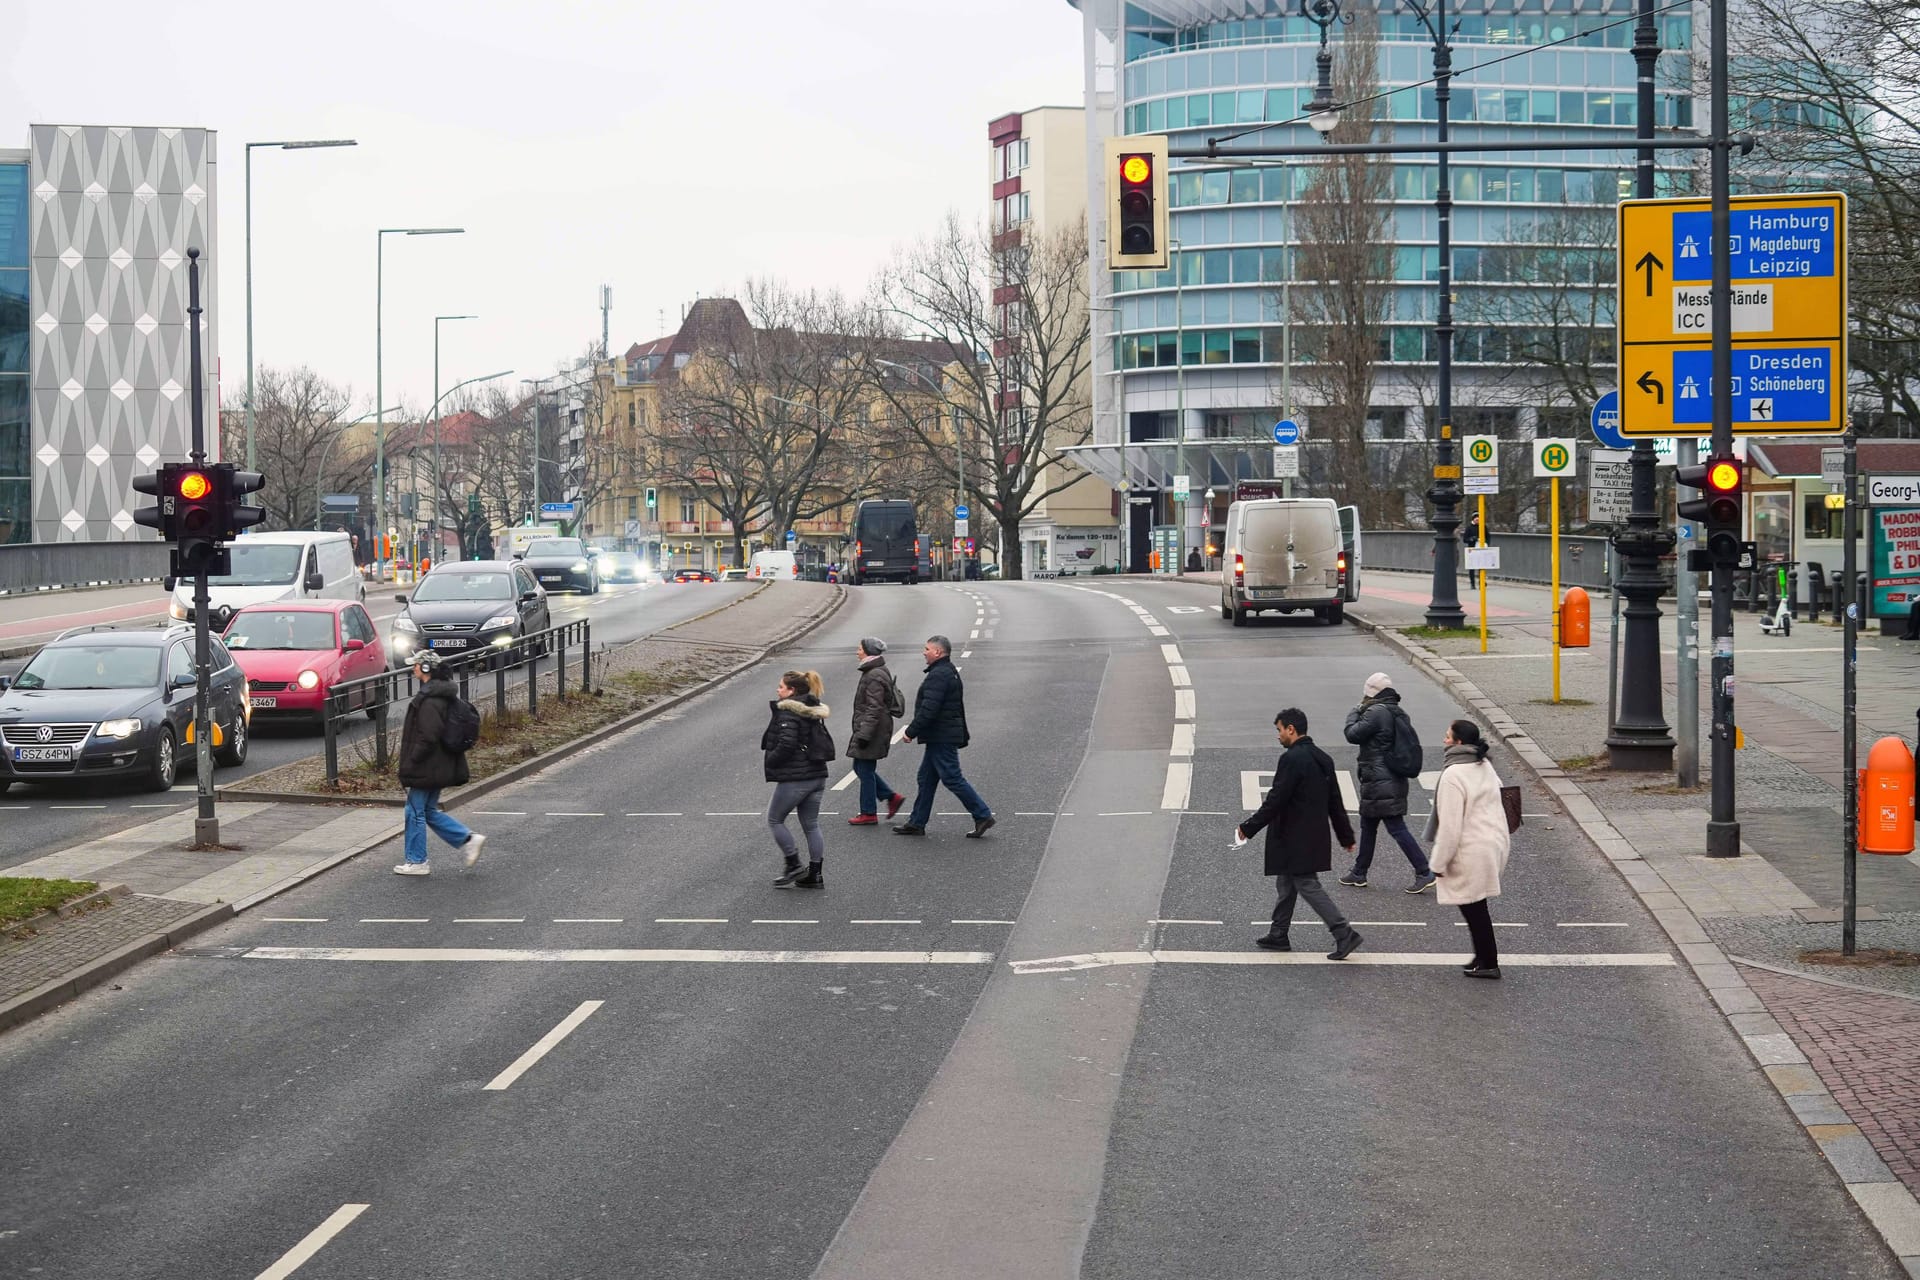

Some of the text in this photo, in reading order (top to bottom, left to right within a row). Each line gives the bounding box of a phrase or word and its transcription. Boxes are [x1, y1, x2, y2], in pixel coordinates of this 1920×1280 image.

[1749, 213, 1829, 232] Hamburg
[1750, 235, 1821, 254] Magdeburg
[1749, 257, 1811, 276] Leipzig
[1678, 290, 1768, 307] Messlände
[1678, 313, 1705, 328] ICC
[1750, 354, 1822, 370] Dresden
[1750, 376, 1825, 394] Schöneberg
[1872, 481, 1920, 501] Georg-
[1893, 555, 1904, 569] &
[255, 698, 275, 707] 3467
[21, 748, 70, 760] GSZ 64PM
